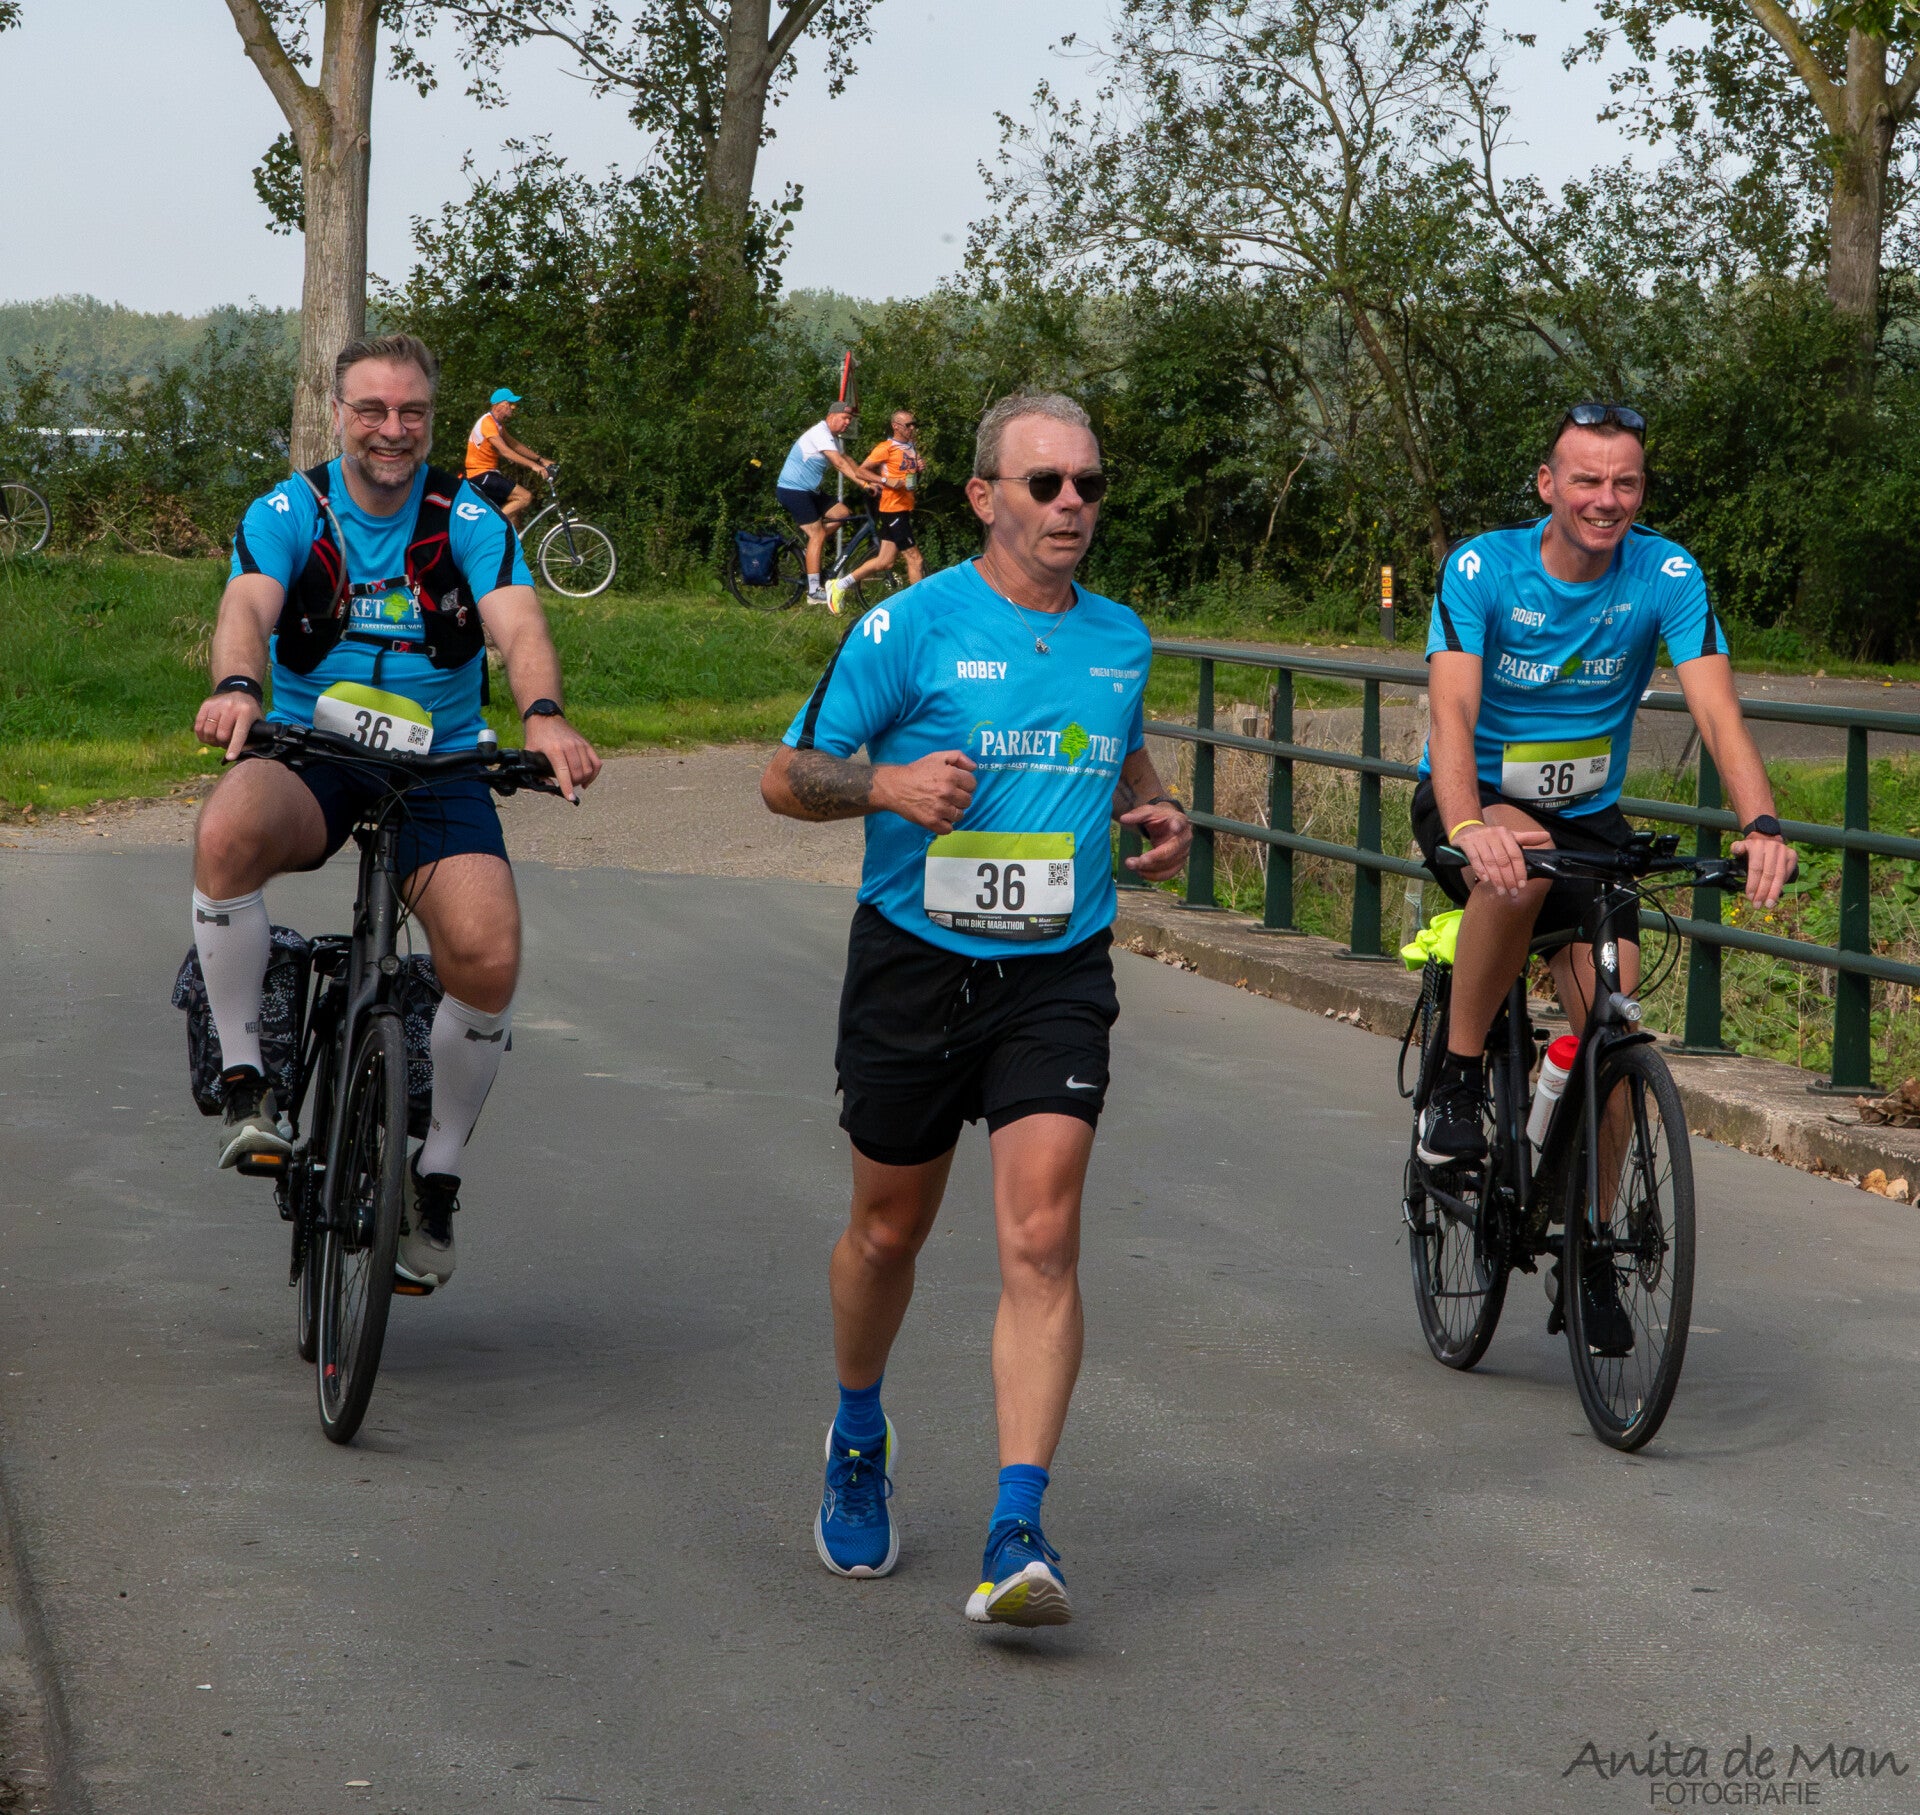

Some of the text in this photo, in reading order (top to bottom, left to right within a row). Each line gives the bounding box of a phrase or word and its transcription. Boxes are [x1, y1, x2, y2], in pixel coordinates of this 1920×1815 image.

[1511, 606, 1546, 627] ROBEY
[957, 660, 1007, 680] ROBEY
[1497, 653, 1561, 683] PARKET
[350, 711, 392, 750] 36
[980, 730, 1121, 764] PARKET TRE
[1030, 763, 1082, 774] PARKETWINKE
[1538, 762, 1575, 796] 36
[976, 862, 1026, 911] 36
[955, 918, 970, 927] RUN
[970, 919, 986, 929] BIKE
[987, 920, 1025, 931] MARATHON
